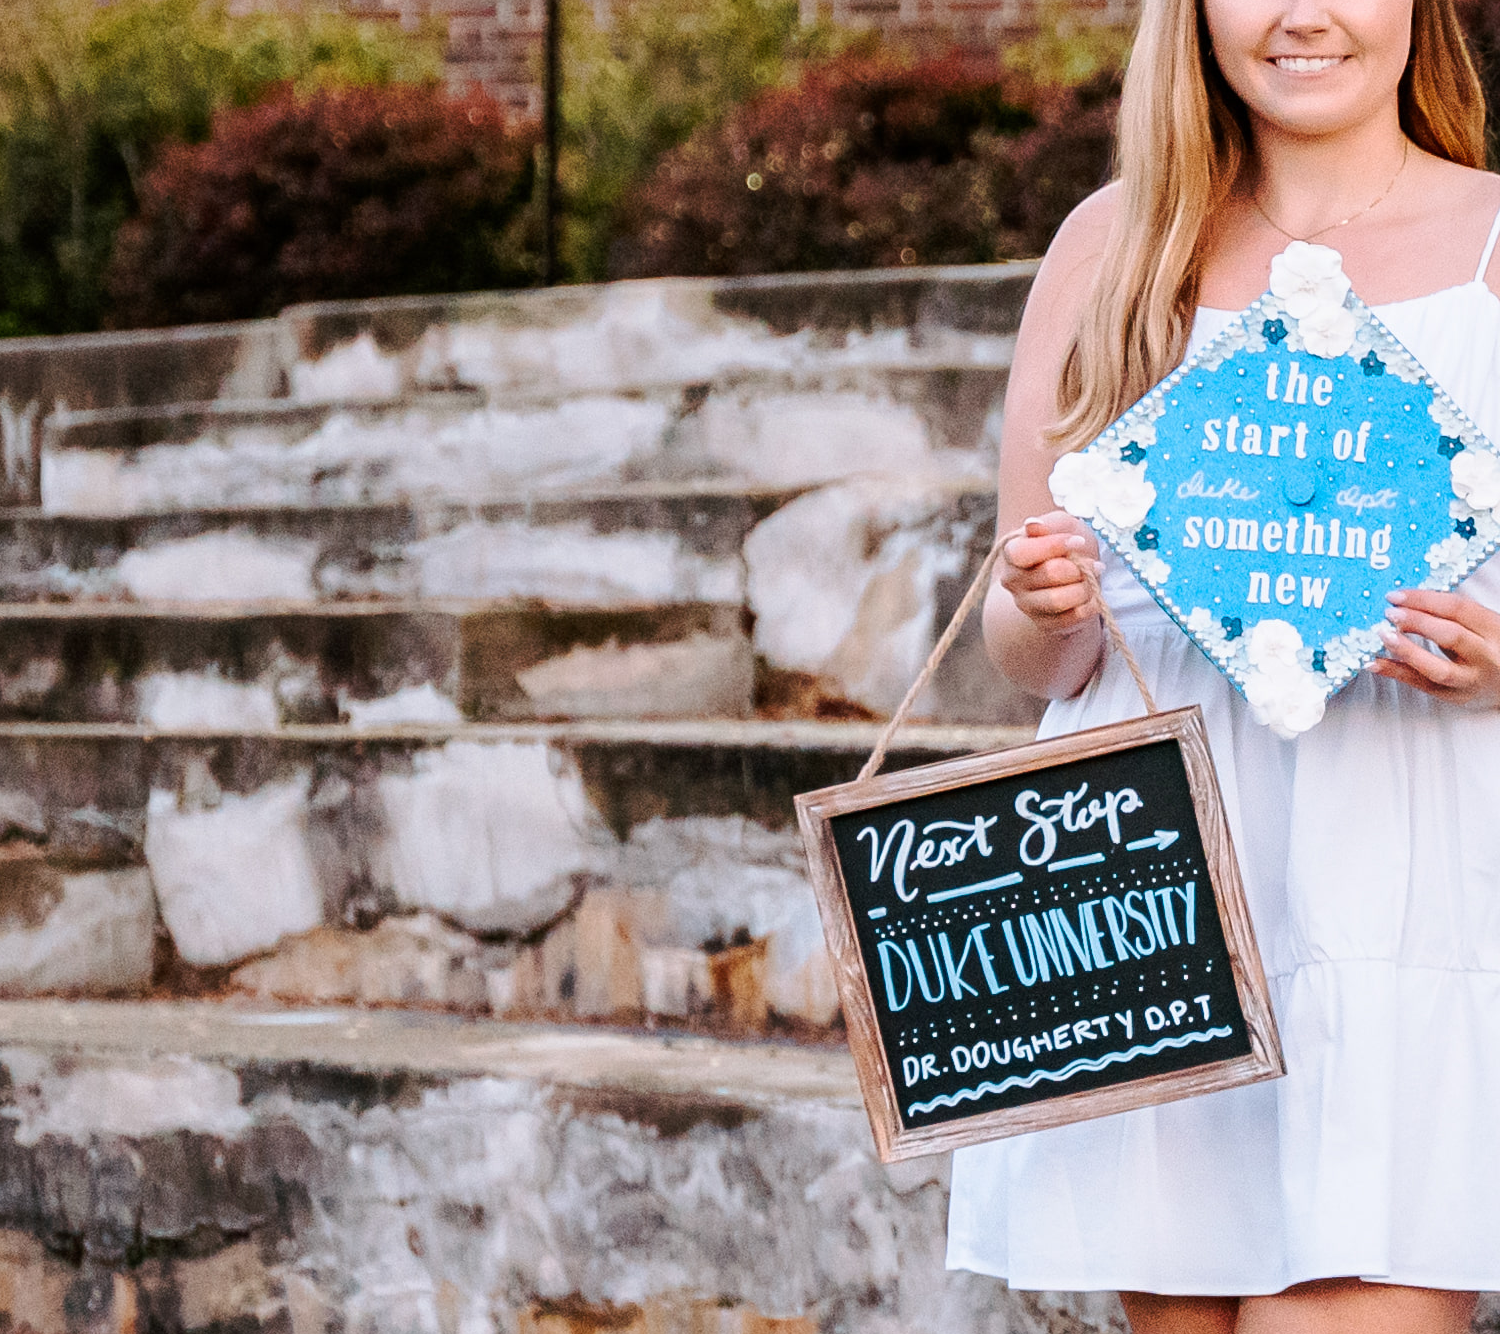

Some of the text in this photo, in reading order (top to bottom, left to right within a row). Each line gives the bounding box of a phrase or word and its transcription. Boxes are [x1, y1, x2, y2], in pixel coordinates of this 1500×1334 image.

[1266, 361, 1334, 407] the
[1201, 414, 1373, 464] start of
[1182, 512, 1393, 571] something
[1246, 571, 1332, 609] new
[856, 781, 1144, 903] Next Stop
[876, 881, 1197, 1012] DUKE UNIVERSITY
[902, 994, 1212, 1088] DR. DOUGHERTY D.P.T
